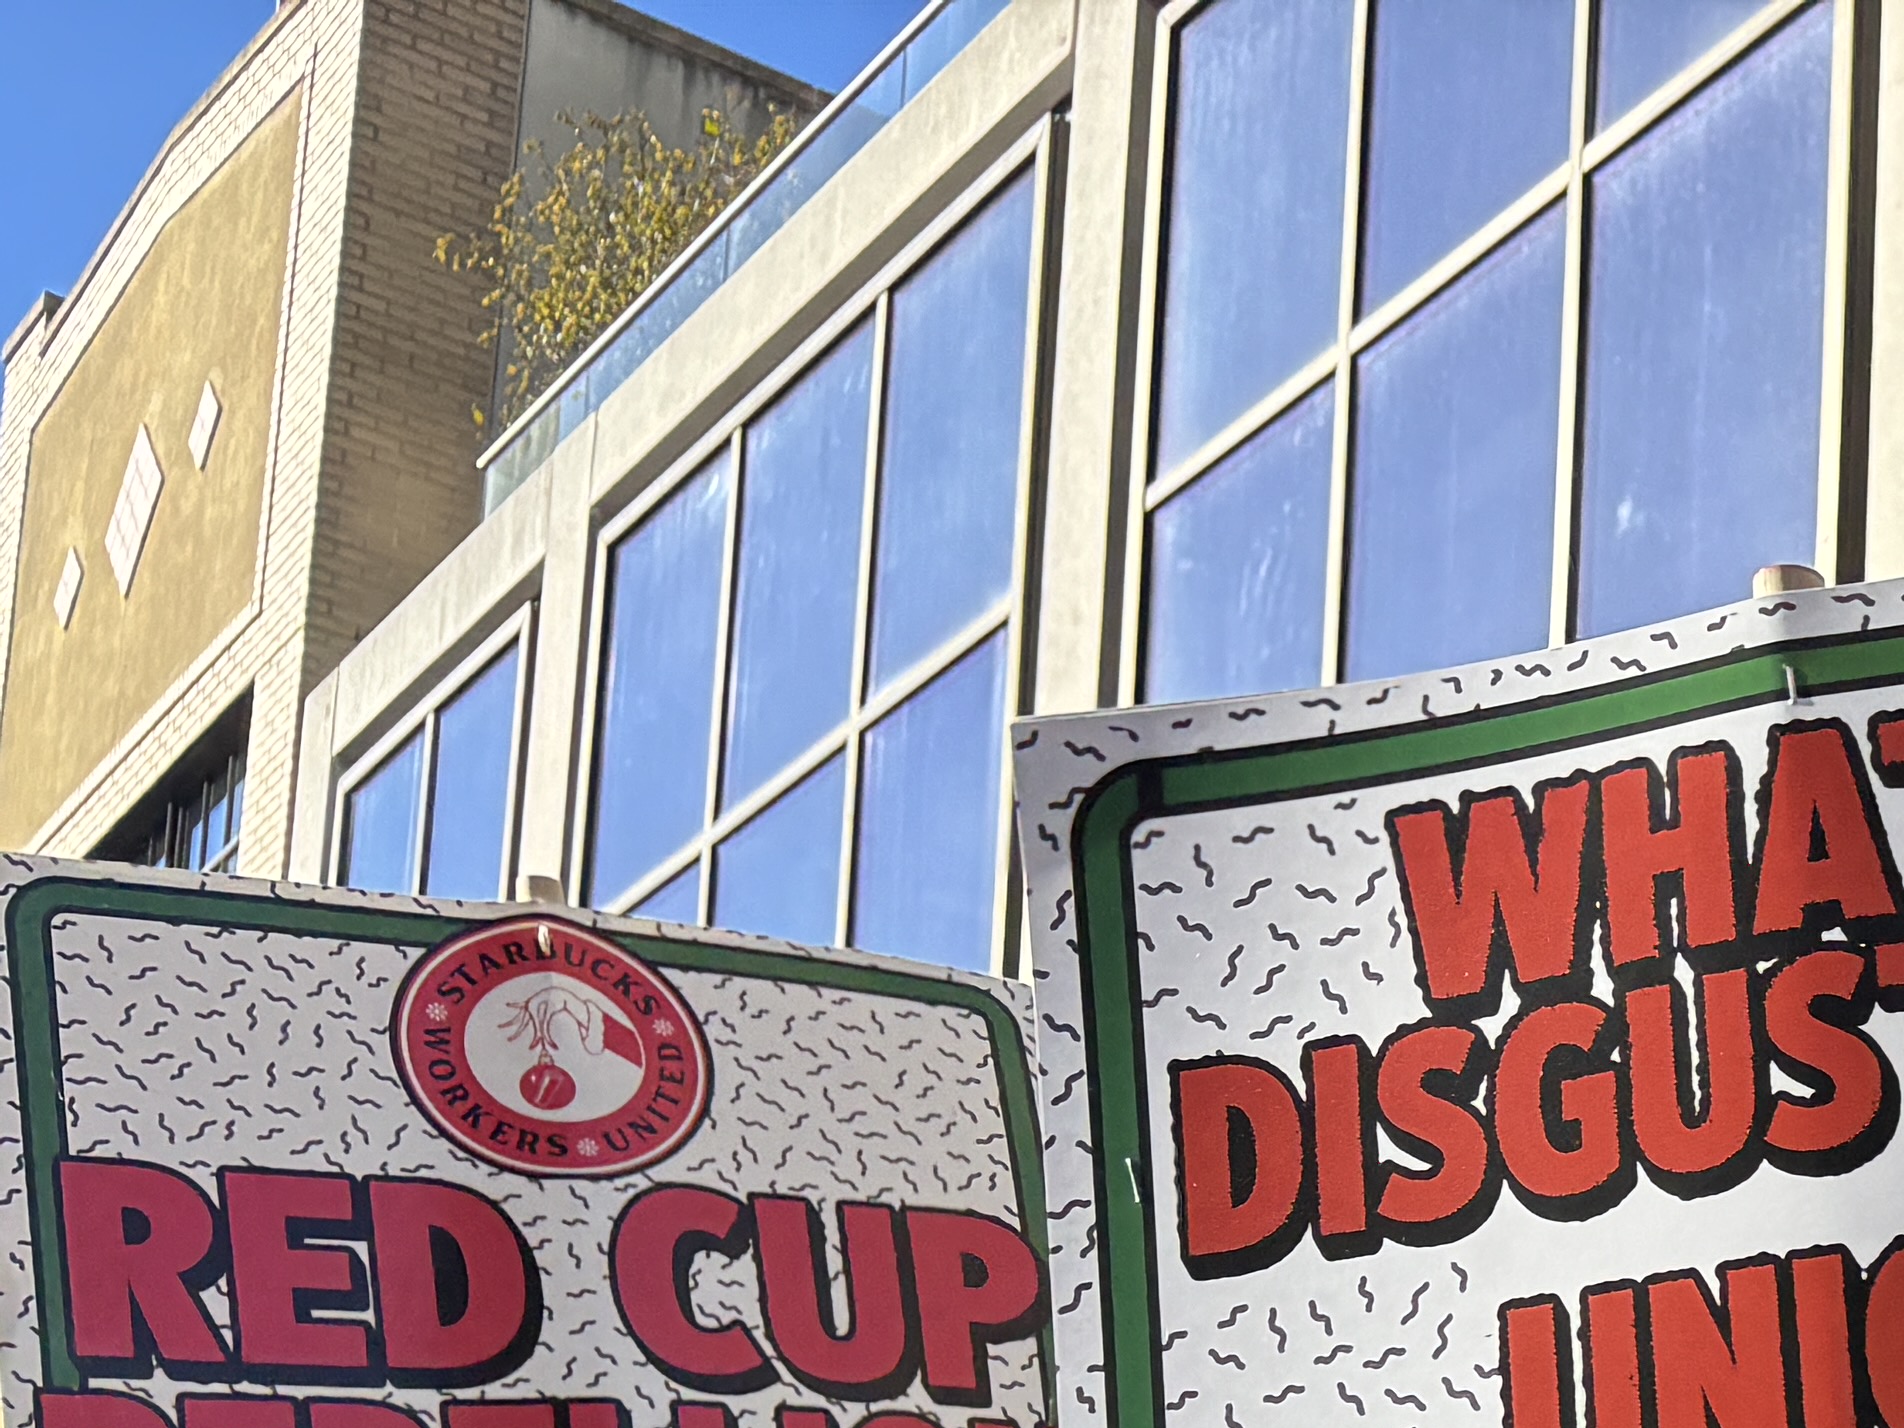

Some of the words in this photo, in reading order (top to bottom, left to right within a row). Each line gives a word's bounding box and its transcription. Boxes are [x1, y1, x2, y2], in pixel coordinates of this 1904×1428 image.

[438, 938, 660, 1016] STARBUCKS
[424, 1026, 568, 1157] WORKERS
[604, 1042, 685, 1152] UNITED
[51, 1157, 544, 1386] RED
[607, 1182, 1050, 1407] CUP
